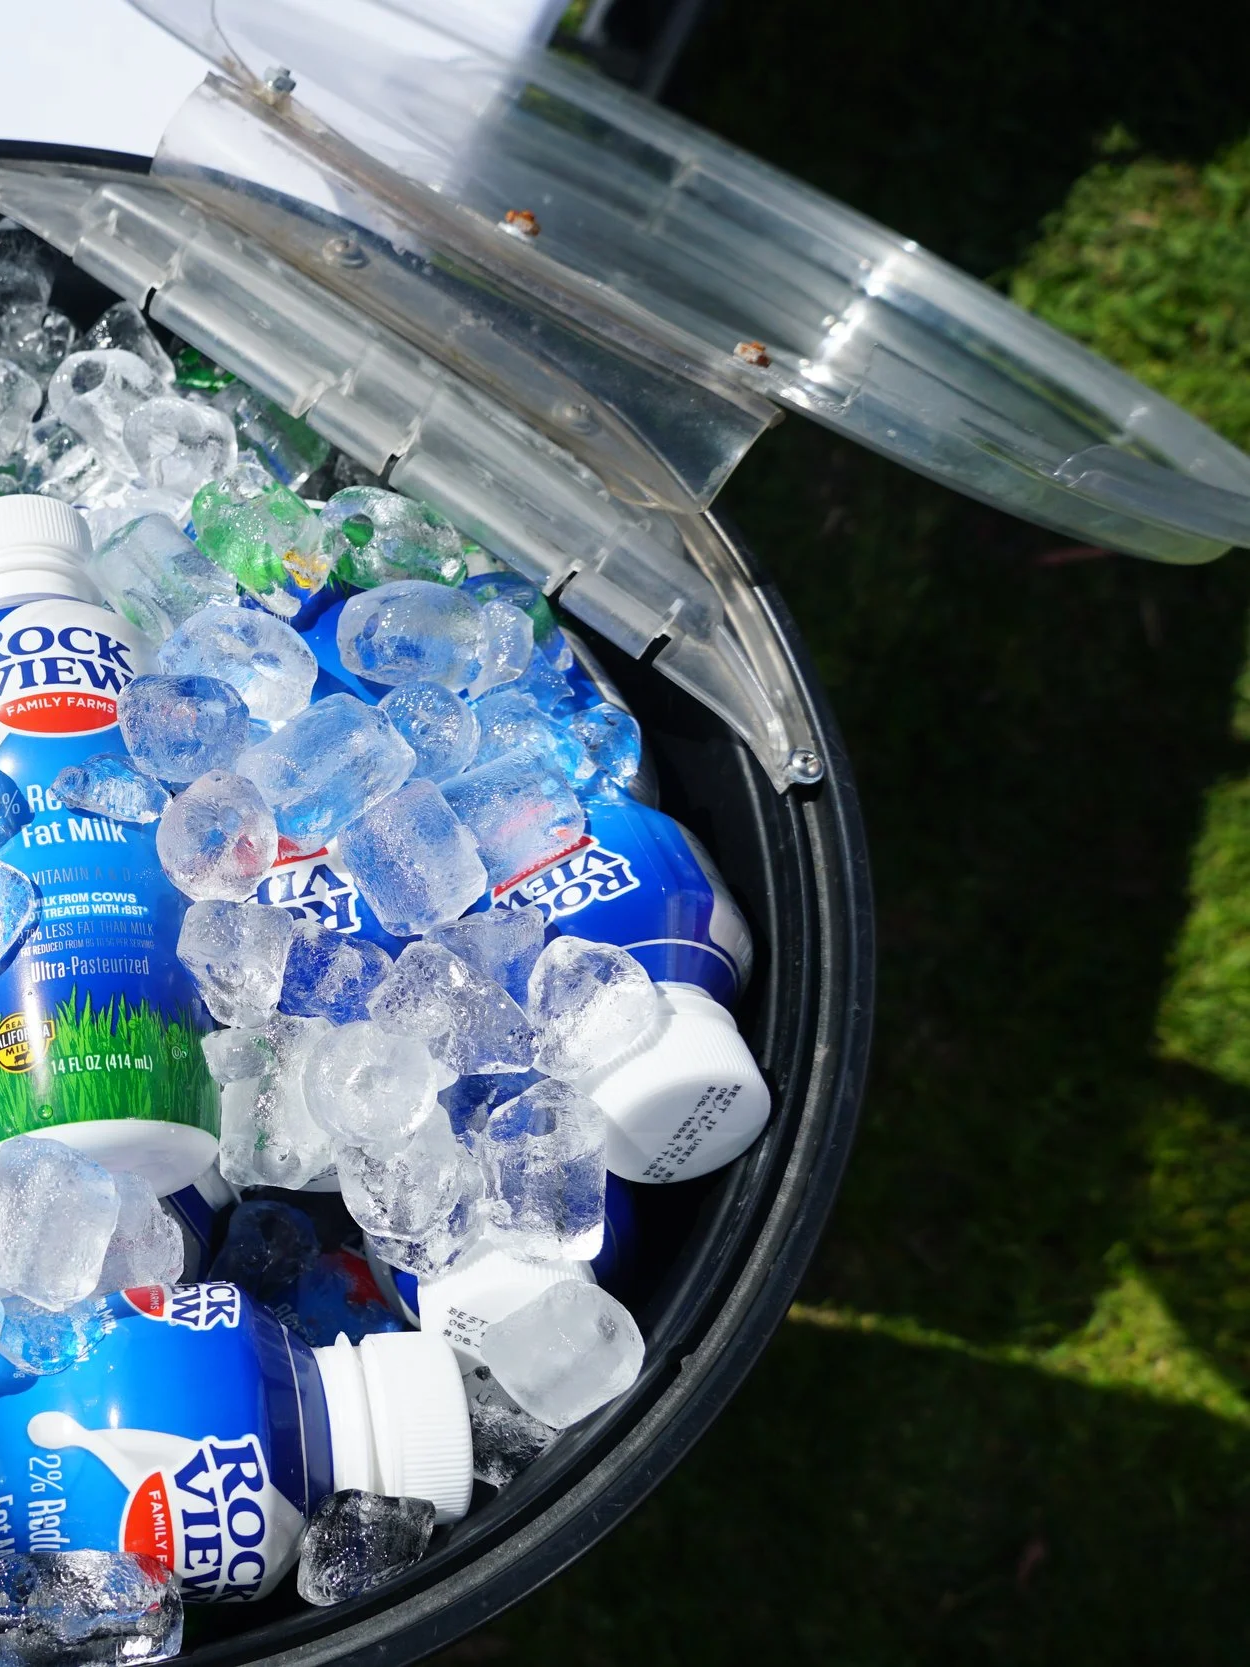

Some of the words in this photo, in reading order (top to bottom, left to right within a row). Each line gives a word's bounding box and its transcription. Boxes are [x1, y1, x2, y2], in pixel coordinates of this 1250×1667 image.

[6, 697, 62, 717] FAMILY
[67, 697, 115, 714] FARMS
[21, 821, 66, 848] Fat
[68, 818, 128, 843] Milk
[32, 867, 89, 886] VITAMIN
[58, 892, 89, 905] FROM
[91, 892, 137, 903] COWS
[43, 904, 90, 918] TREATED
[91, 903, 119, 914] WITH
[17, 926, 43, 944] 37%
[45, 921, 74, 939] LESS
[77, 920, 96, 935] FAT
[100, 920, 127, 934] THAN
[130, 921, 155, 937] MILK
[32, 941, 64, 956] REDUCED
[30, 955, 150, 983] Ultra-Pasteurized
[51, 1059, 66, 1075] 14
[69, 1056, 83, 1072] FL
[85, 1055, 102, 1071] OZ
[105, 1053, 131, 1072] (414
[134, 1054, 153, 1073] mL)
[718, 1083, 743, 1114] BEST
[705, 1119, 718, 1132] IF
[676, 1138, 703, 1165] USED
[447, 1306, 489, 1328] BEST
[28, 1454, 64, 1493] 2%
[148, 1489, 169, 1546] FAMILY
[209, 1441, 265, 1601] ROCK
